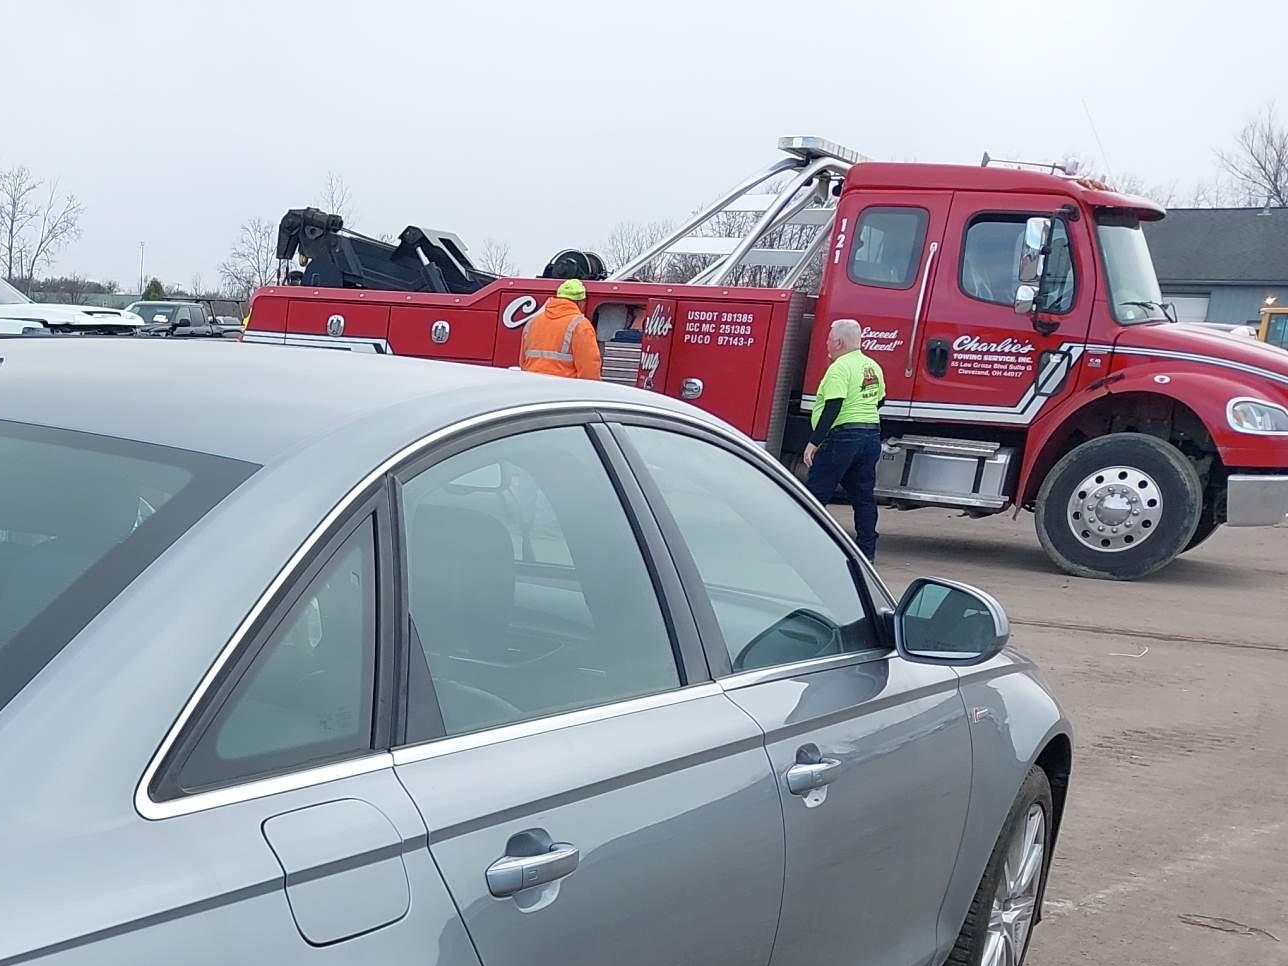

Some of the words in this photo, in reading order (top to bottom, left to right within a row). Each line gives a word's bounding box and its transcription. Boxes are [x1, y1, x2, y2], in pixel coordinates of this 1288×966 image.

[834, 217, 848, 264] 121
[687, 311, 718, 321] USDOT
[685, 322, 700, 332] ICC
[701, 323, 716, 333] MC
[861, 326, 898, 338] Exceed
[684, 334, 711, 344] PUCO
[717, 336, 755, 347] 97143-P
[952, 335, 1035, 354] Charlie's
[953, 353, 982, 361] TOWING
[983, 354, 1017, 363] SERVICE,
[1018, 356, 1033, 364] INC.
